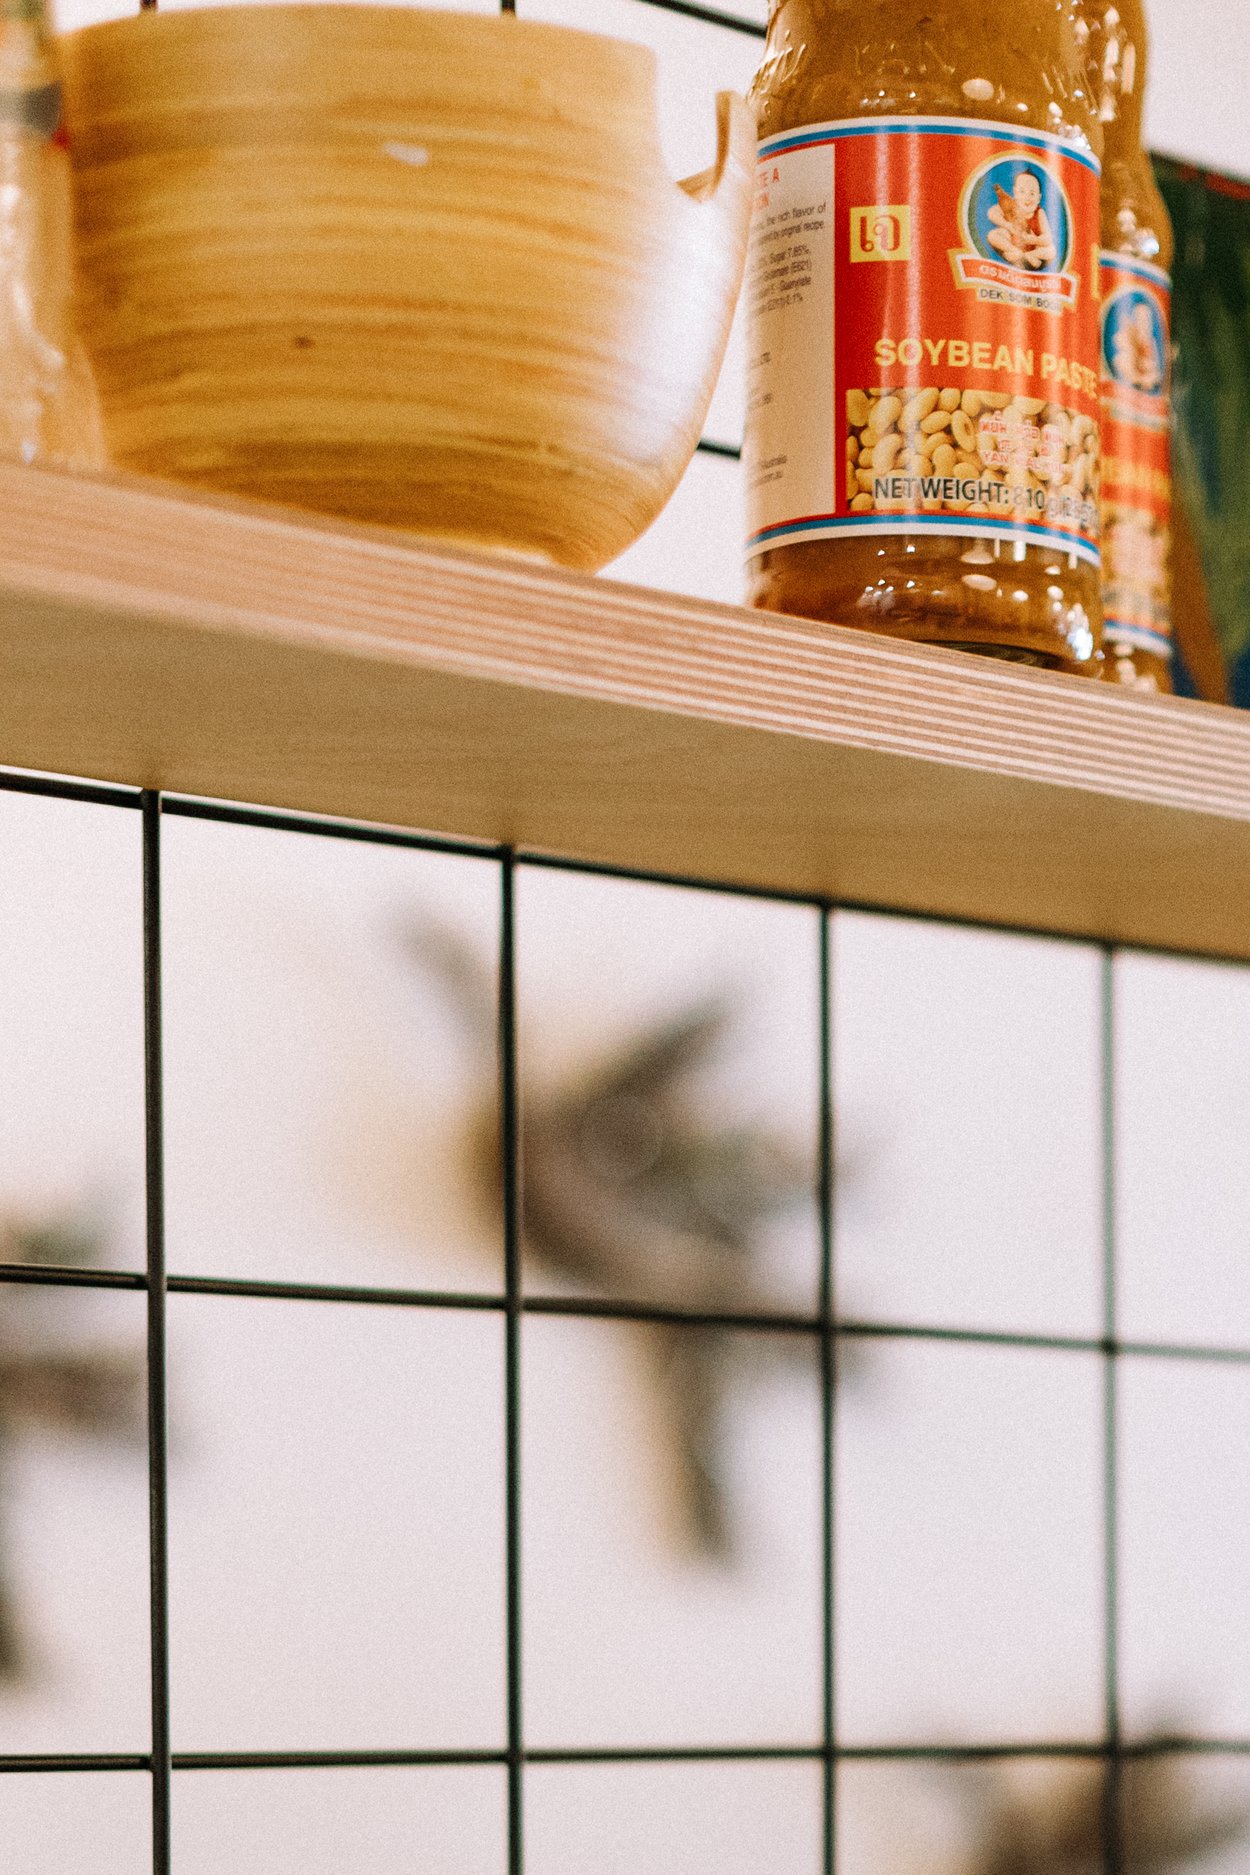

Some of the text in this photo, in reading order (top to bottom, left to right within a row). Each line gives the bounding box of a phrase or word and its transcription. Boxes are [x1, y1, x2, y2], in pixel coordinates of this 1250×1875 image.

[859, 214, 900, 252] เจ
[980, 288, 1004, 301] DEK
[874, 338, 1098, 399] SOYBEAN PASTE
[874, 477, 917, 500] NET
[919, 477, 1010, 505] WEIGHT:
